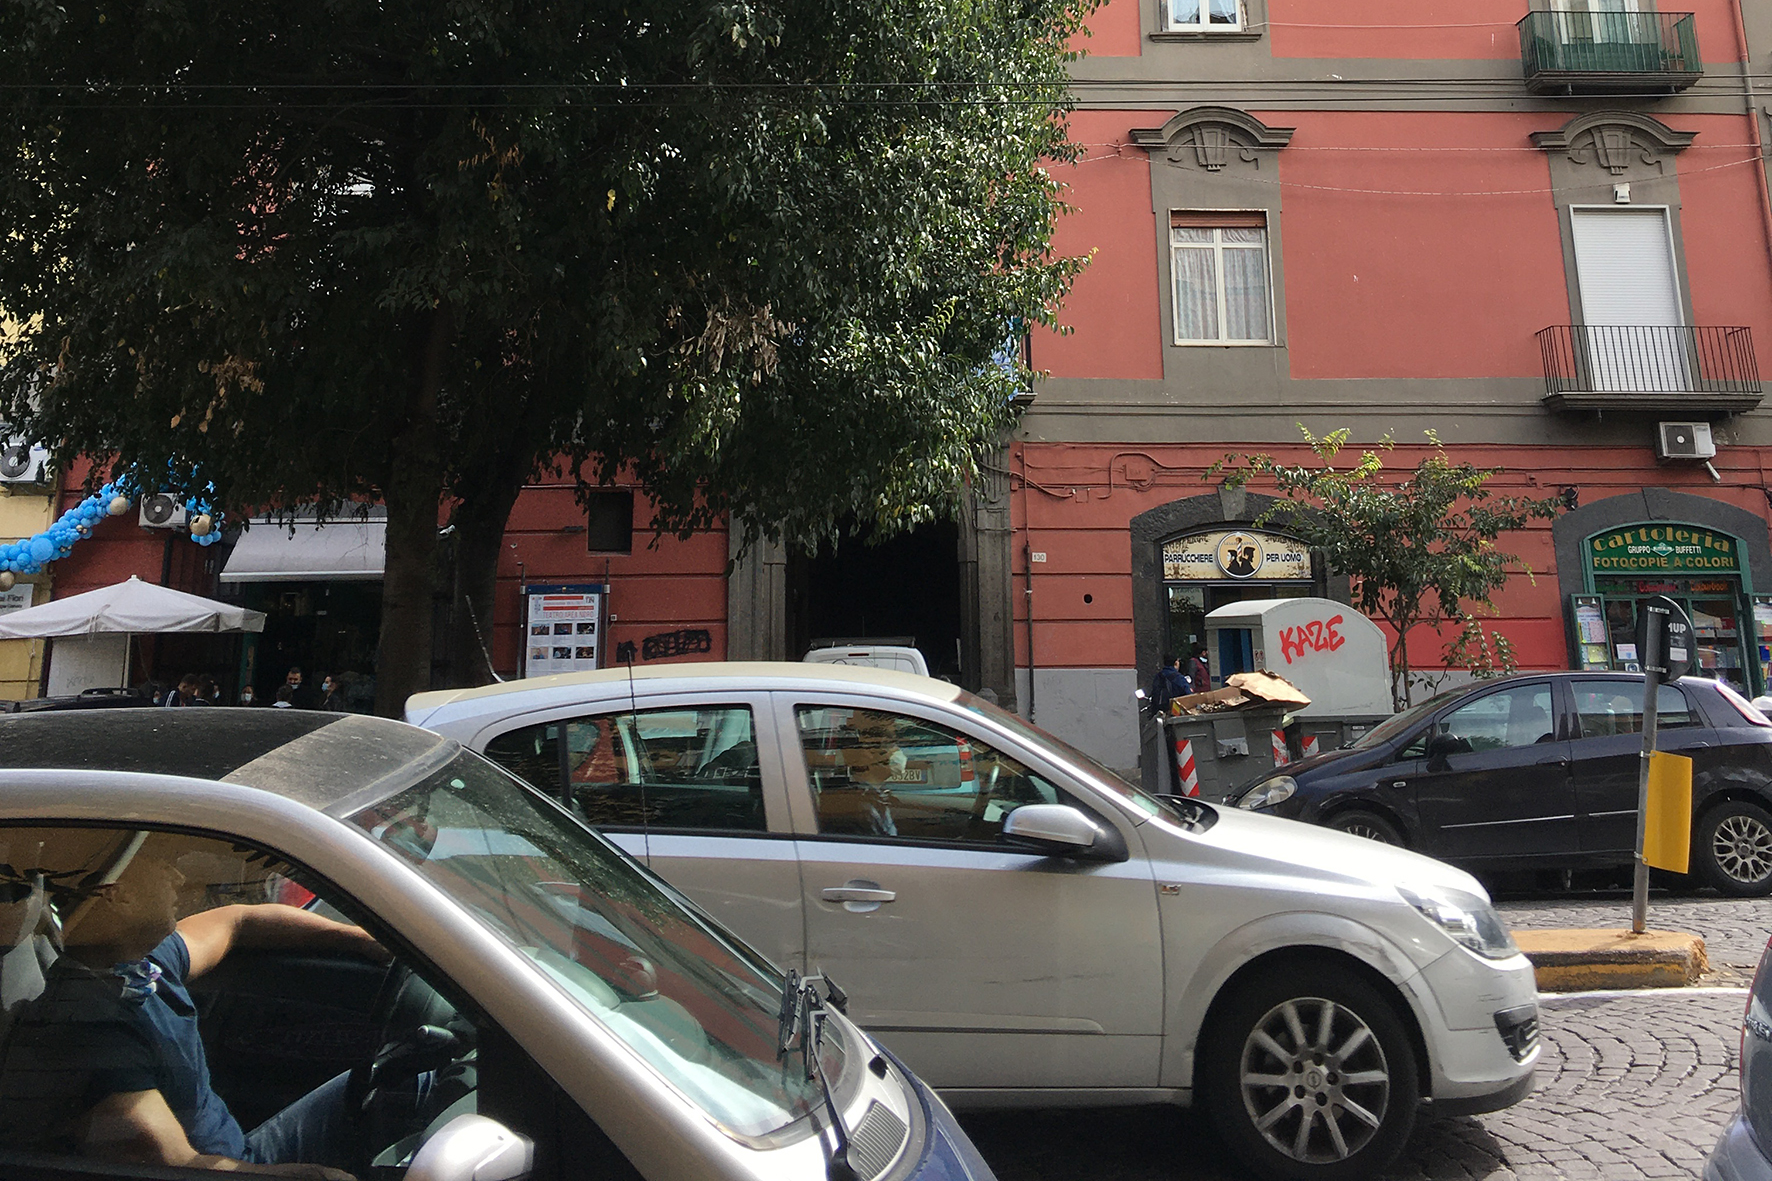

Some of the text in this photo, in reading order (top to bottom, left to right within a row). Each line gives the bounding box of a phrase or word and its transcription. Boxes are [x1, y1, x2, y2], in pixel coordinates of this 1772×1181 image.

[1593, 527, 1729, 553] cartoleria
[1627, 545, 1651, 554] GRUPPO
[1675, 545, 1702, 555] BUFFETTI
[1164, 553, 1302, 563] PARRUCCHIERE PER UOMO
[1593, 557, 1734, 568] FOTOCOPIE A COLORI
[543, 611, 563, 619] TEATRO
[1667, 622, 1687, 634] 1UP
[1279, 614, 1346, 665] KAZE
